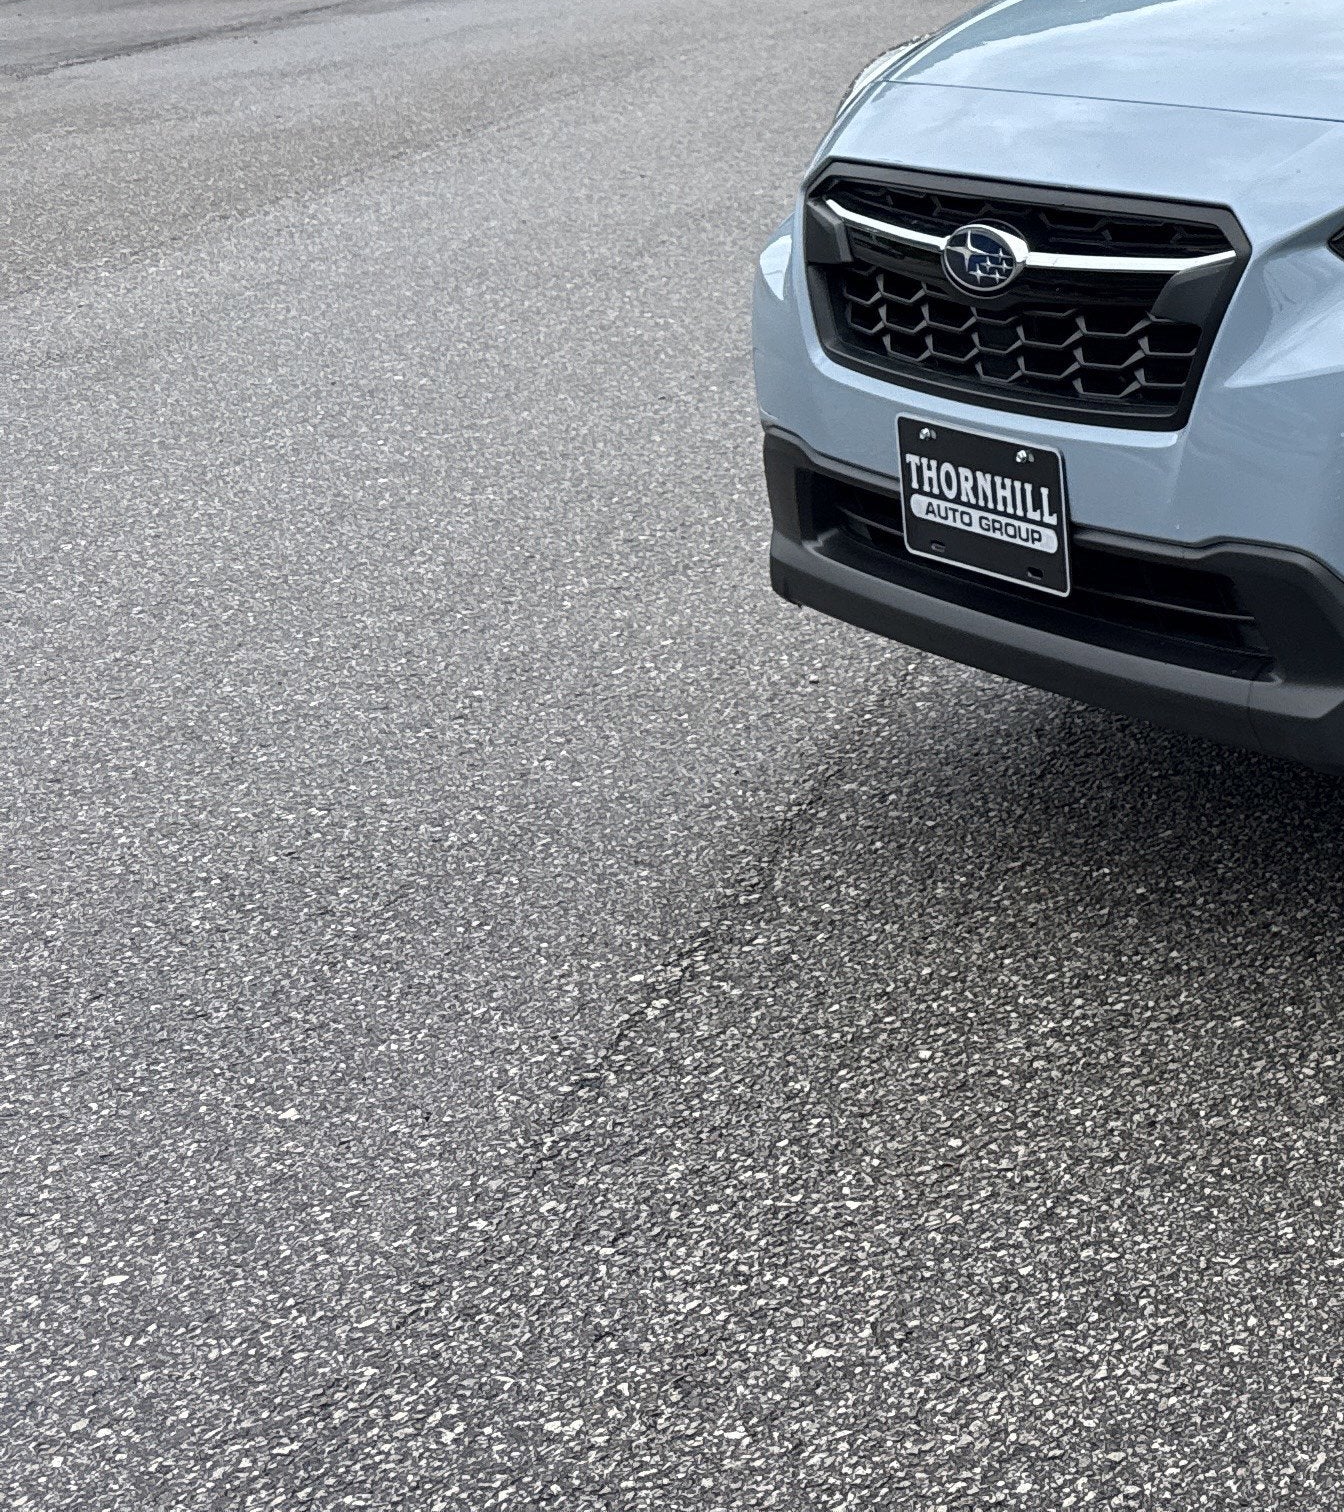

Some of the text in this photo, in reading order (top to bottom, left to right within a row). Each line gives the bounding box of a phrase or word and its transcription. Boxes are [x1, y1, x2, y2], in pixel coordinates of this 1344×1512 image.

[905, 453, 1058, 526] THORNHILL
[925, 501, 1042, 546] AUTO GROUP
